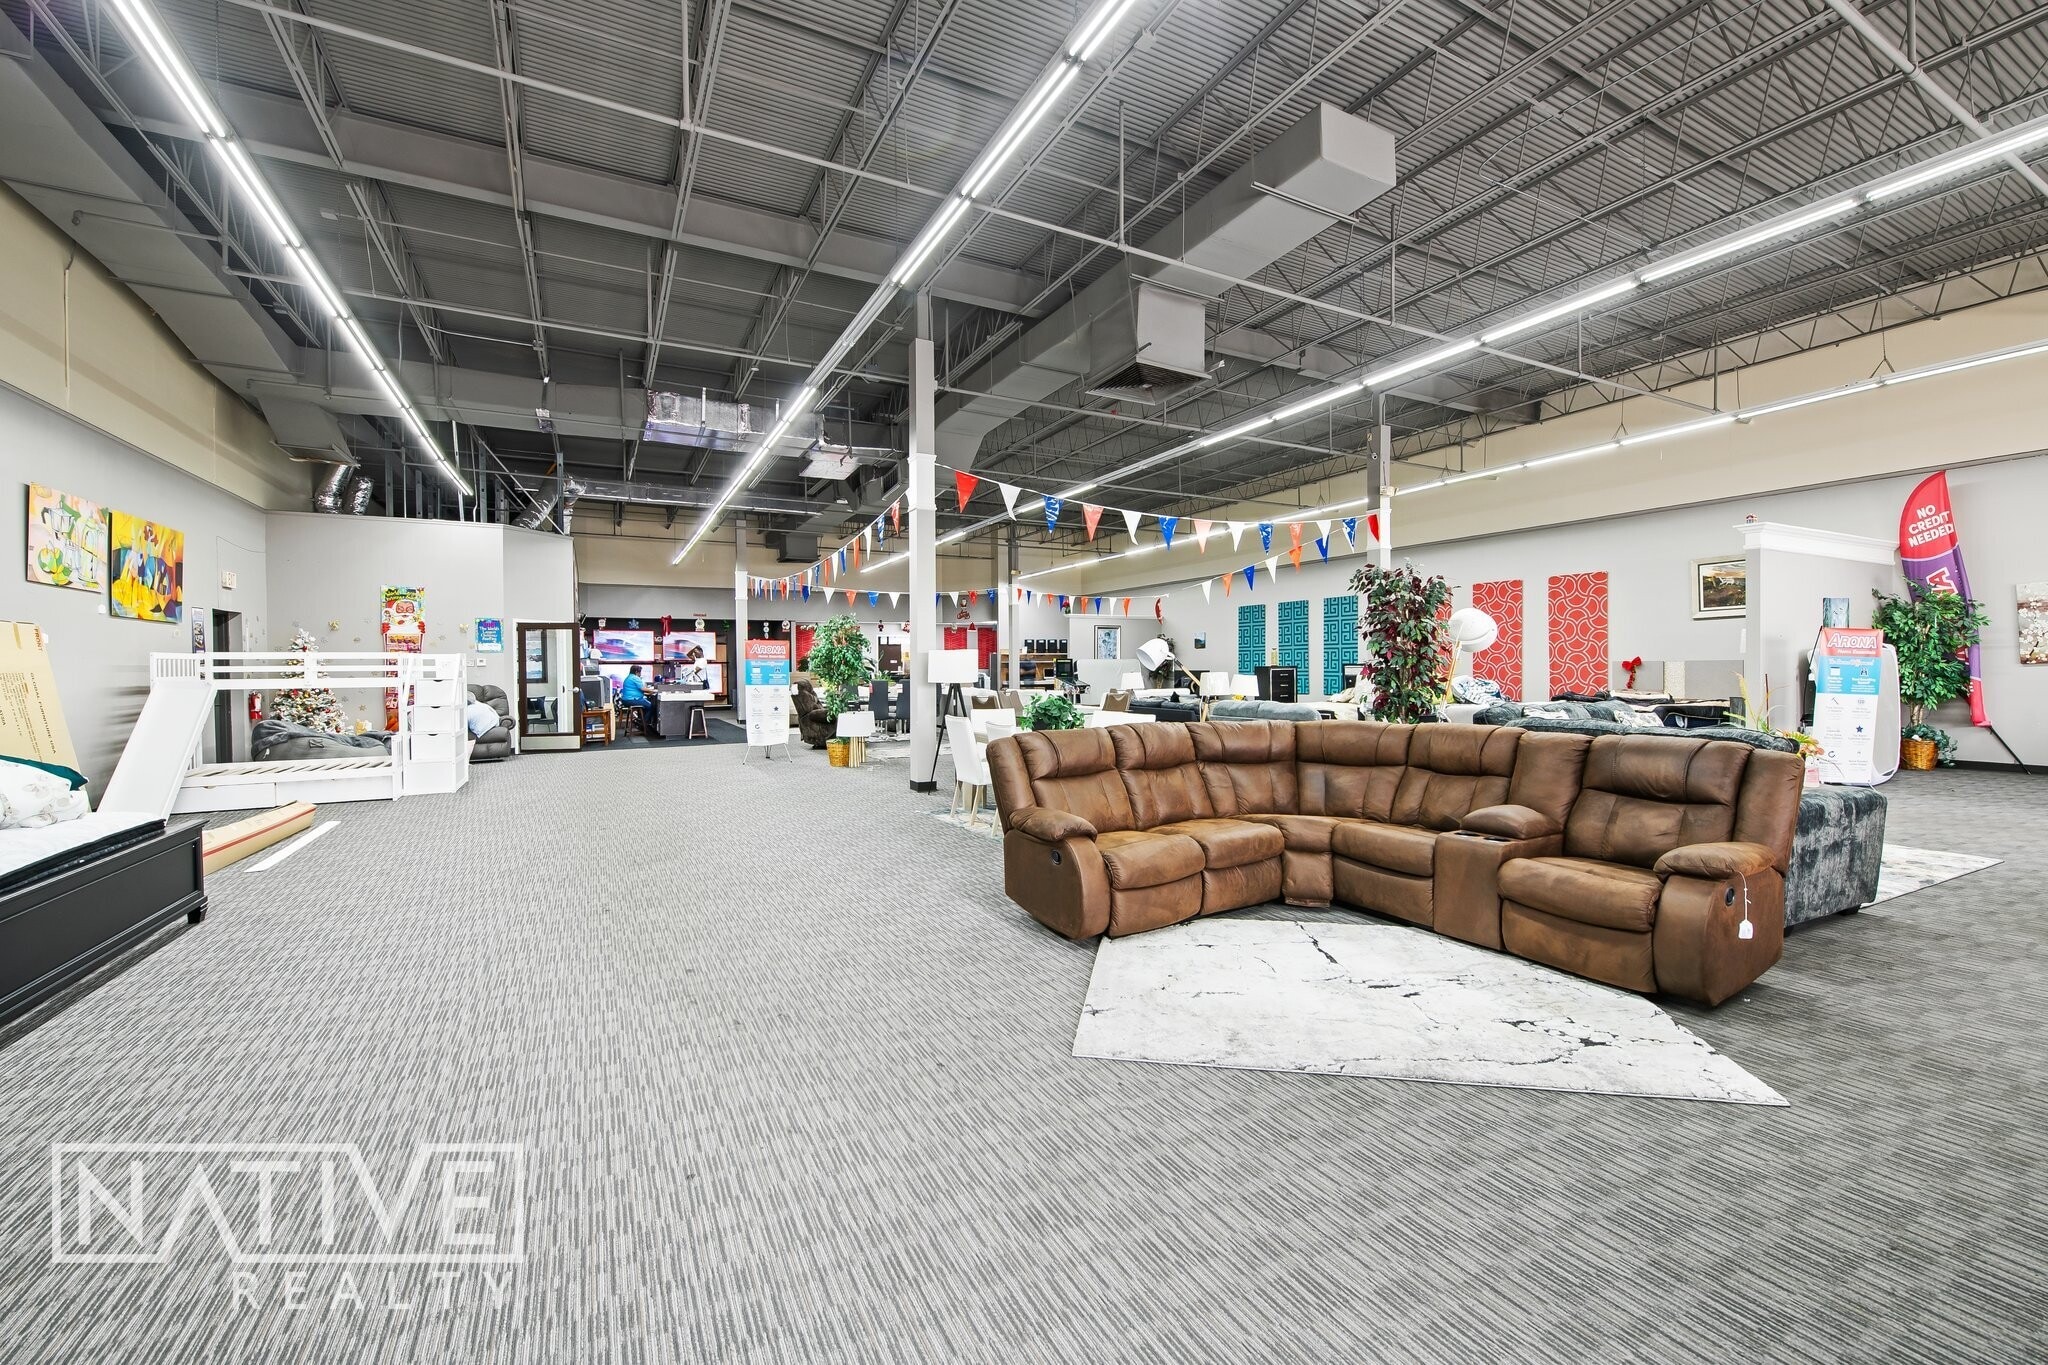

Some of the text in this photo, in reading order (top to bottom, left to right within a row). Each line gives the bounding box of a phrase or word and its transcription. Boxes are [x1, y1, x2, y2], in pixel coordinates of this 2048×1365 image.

[1916, 504, 1936, 519] NO
[1908, 510, 1950, 535] CREDIT
[1908, 523, 1955, 548] NEEDED
[33, 628, 43, 652] FRONT
[750, 643, 786, 655] ARONA
[1826, 631, 1878, 649] ARONA
